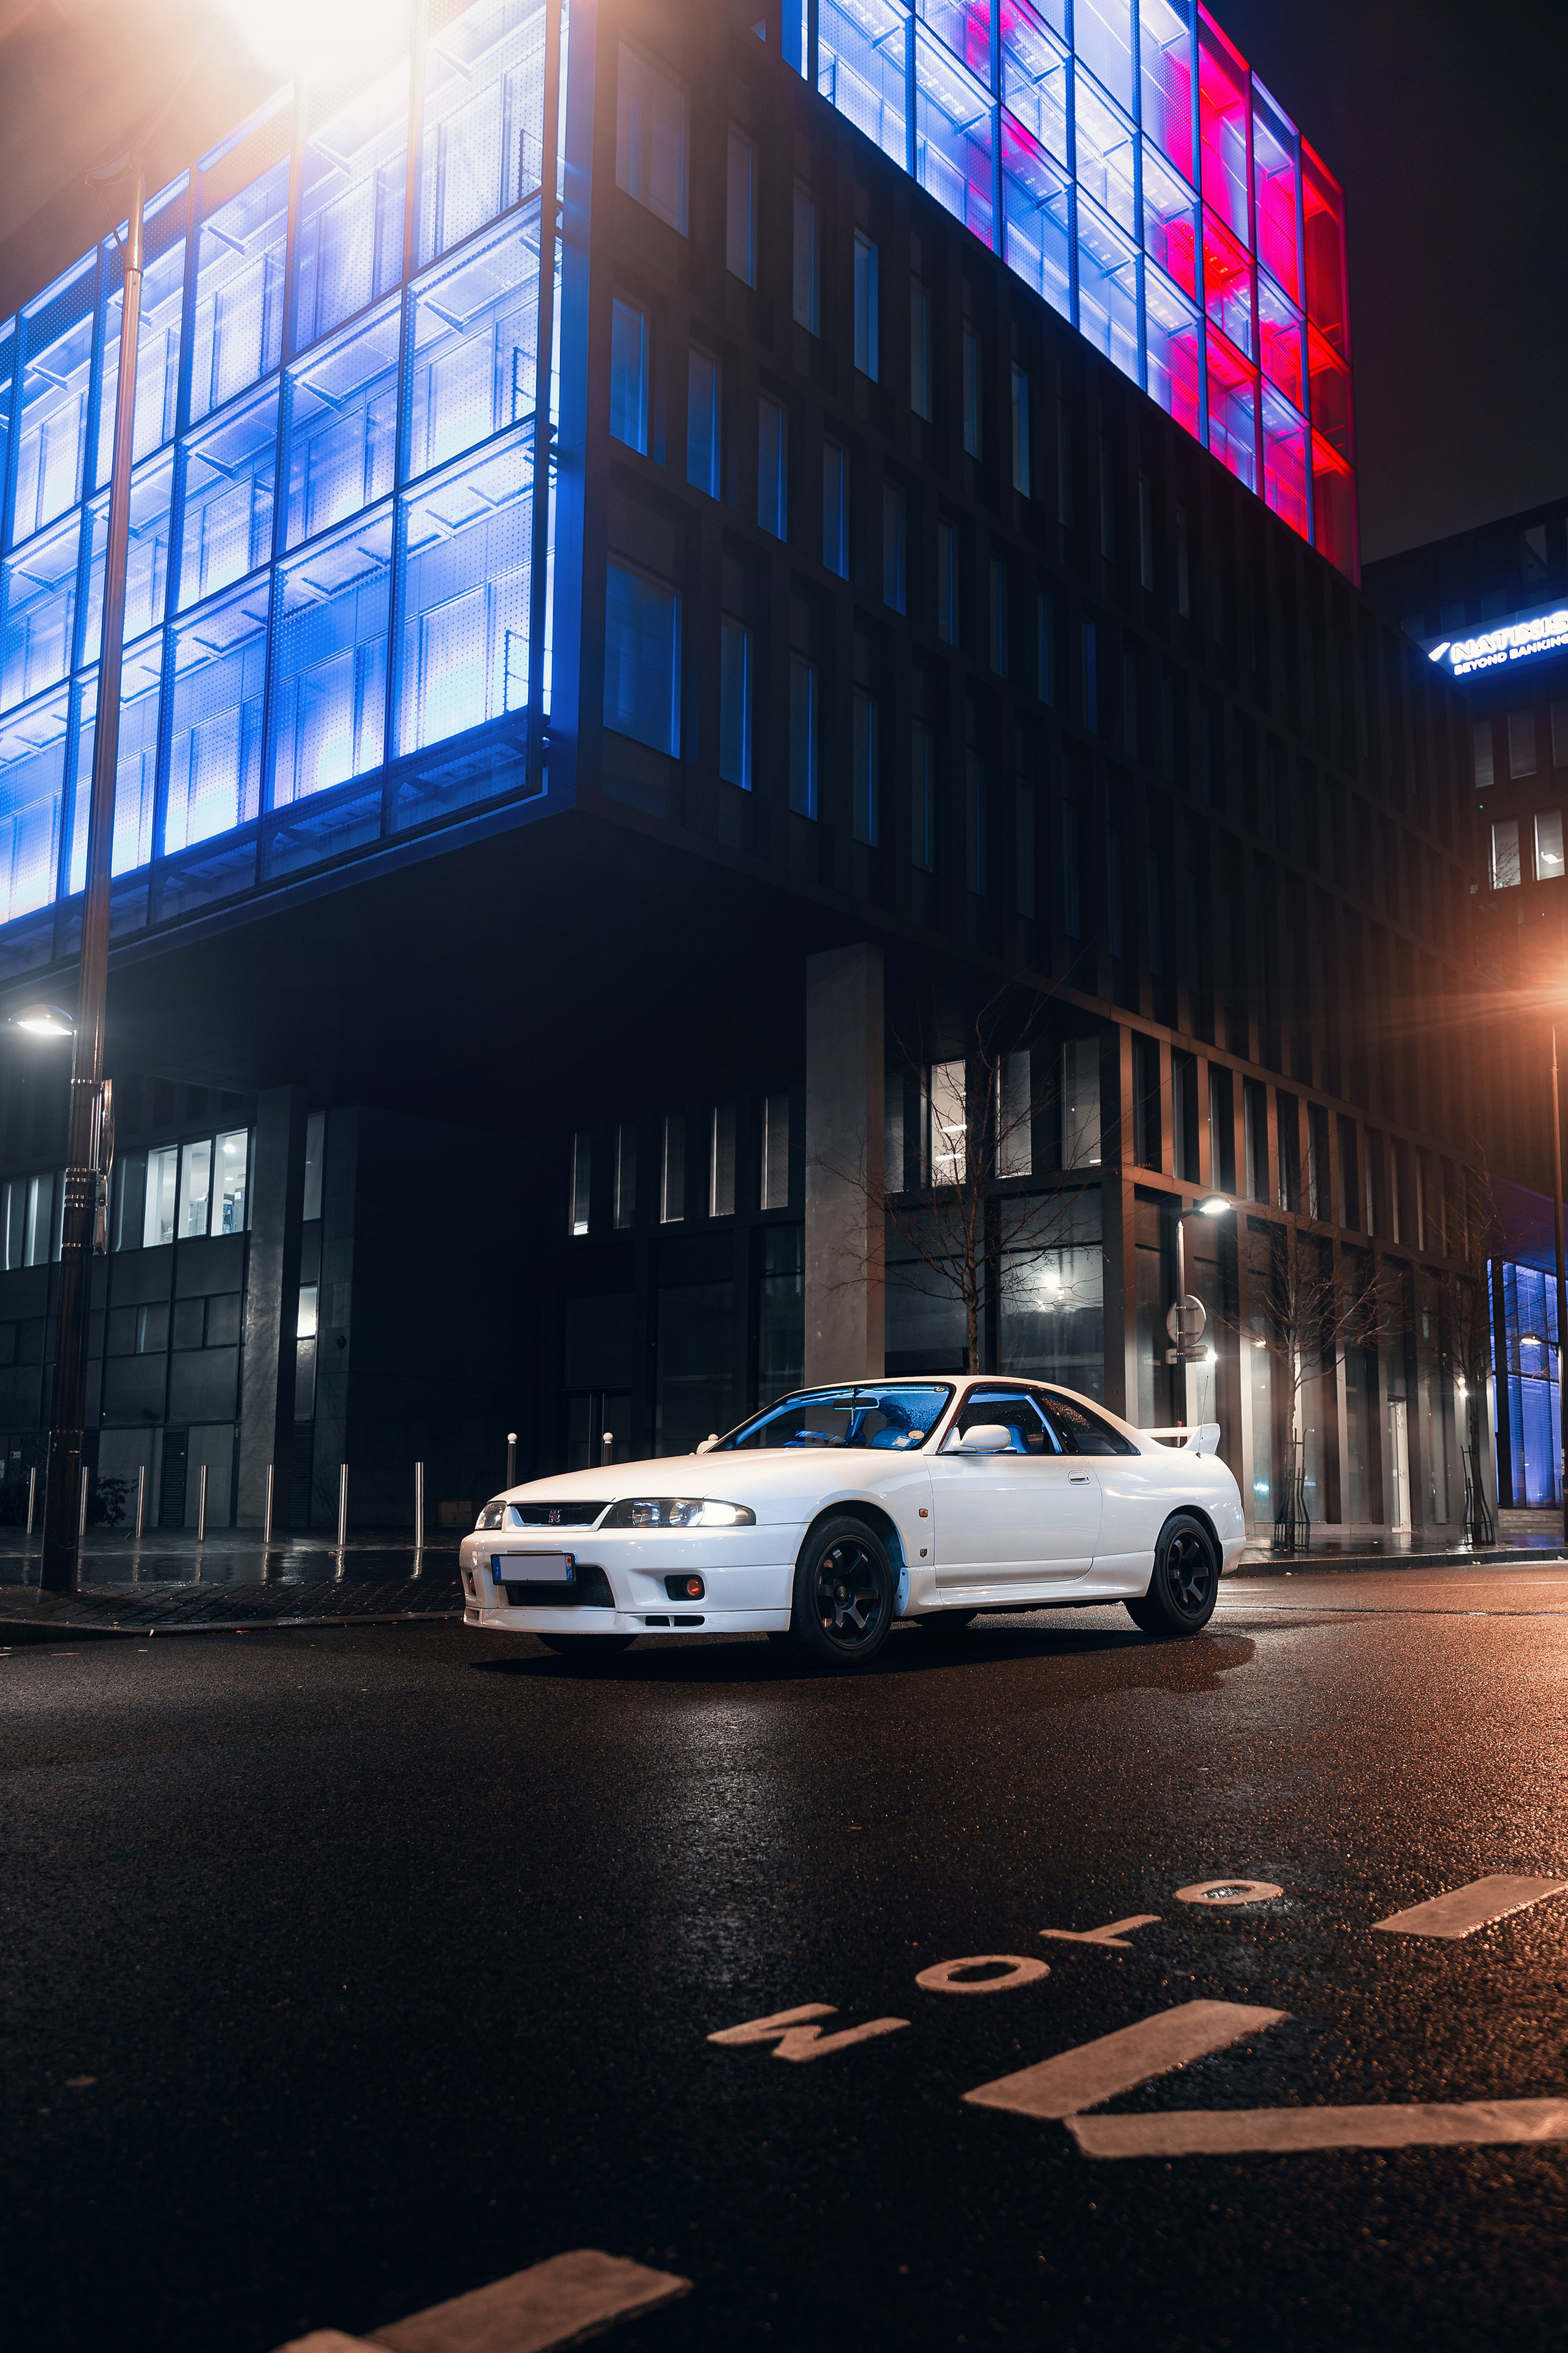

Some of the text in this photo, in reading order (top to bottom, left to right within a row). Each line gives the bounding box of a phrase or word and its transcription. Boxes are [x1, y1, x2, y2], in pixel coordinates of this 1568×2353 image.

[1451, 611, 1568, 663] NATIXIS
[1453, 633, 1568, 676] BEYOND BANKING
[706, 1879, 1284, 2063] MOTO
